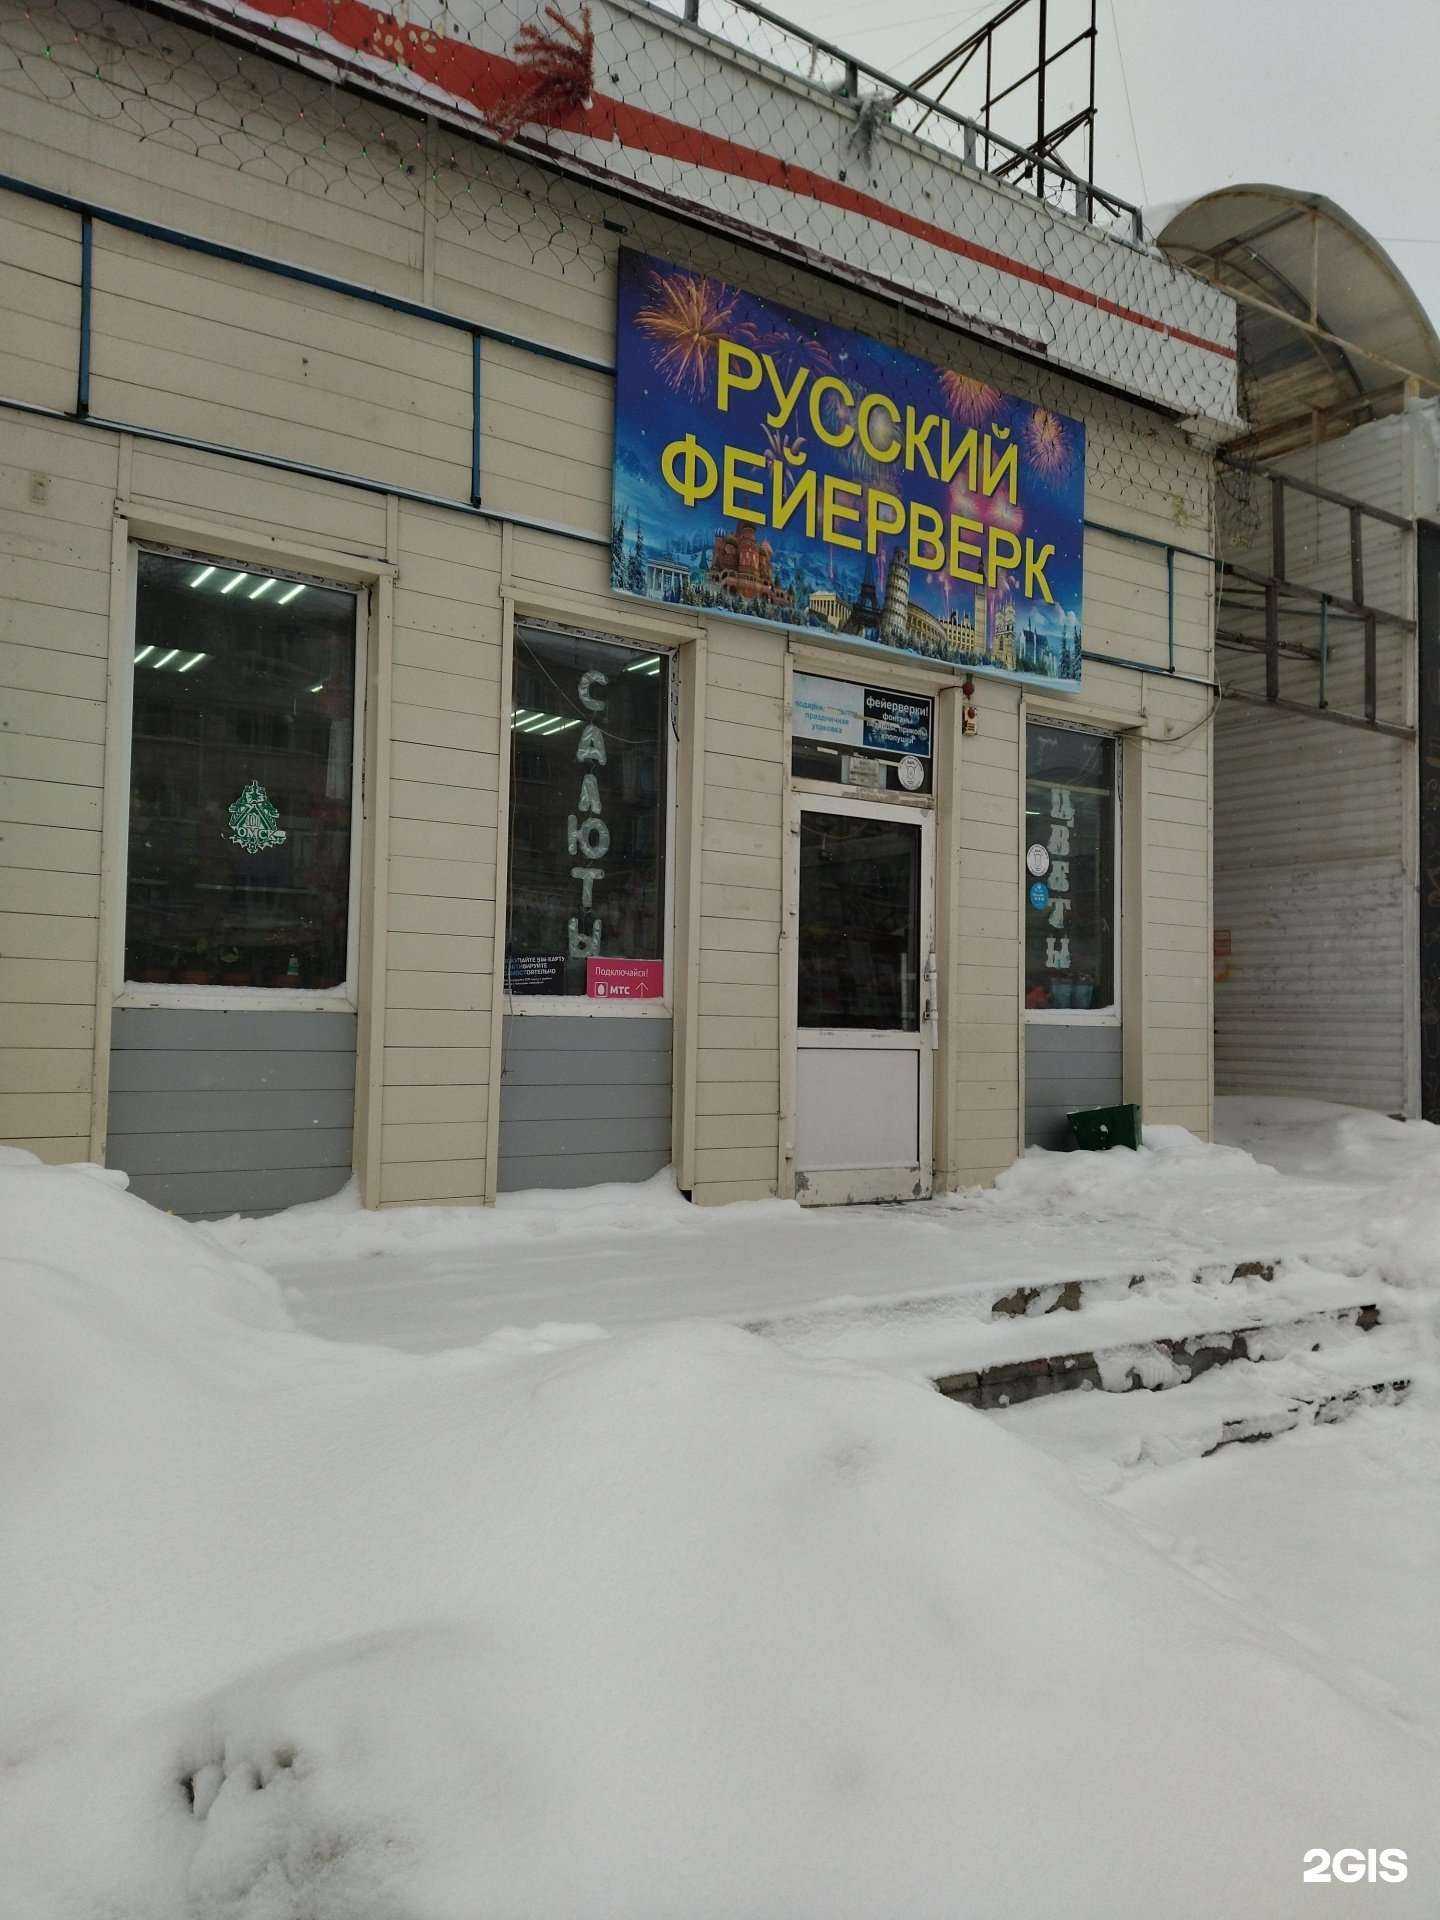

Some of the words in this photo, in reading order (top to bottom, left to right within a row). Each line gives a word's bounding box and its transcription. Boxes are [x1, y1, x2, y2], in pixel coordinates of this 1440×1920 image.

[716, 338, 1019, 506] РУССКИЙ
[660, 433, 1055, 603] ФЕЙЕРВЕРК
[866, 695, 929, 717] фейерверки!
[567, 669, 611, 958] САЛЮТЫ
[237, 826, 276, 842] ОМСК
[595, 966, 649, 978] Подключайся!
[610, 985, 631, 995] МТС
